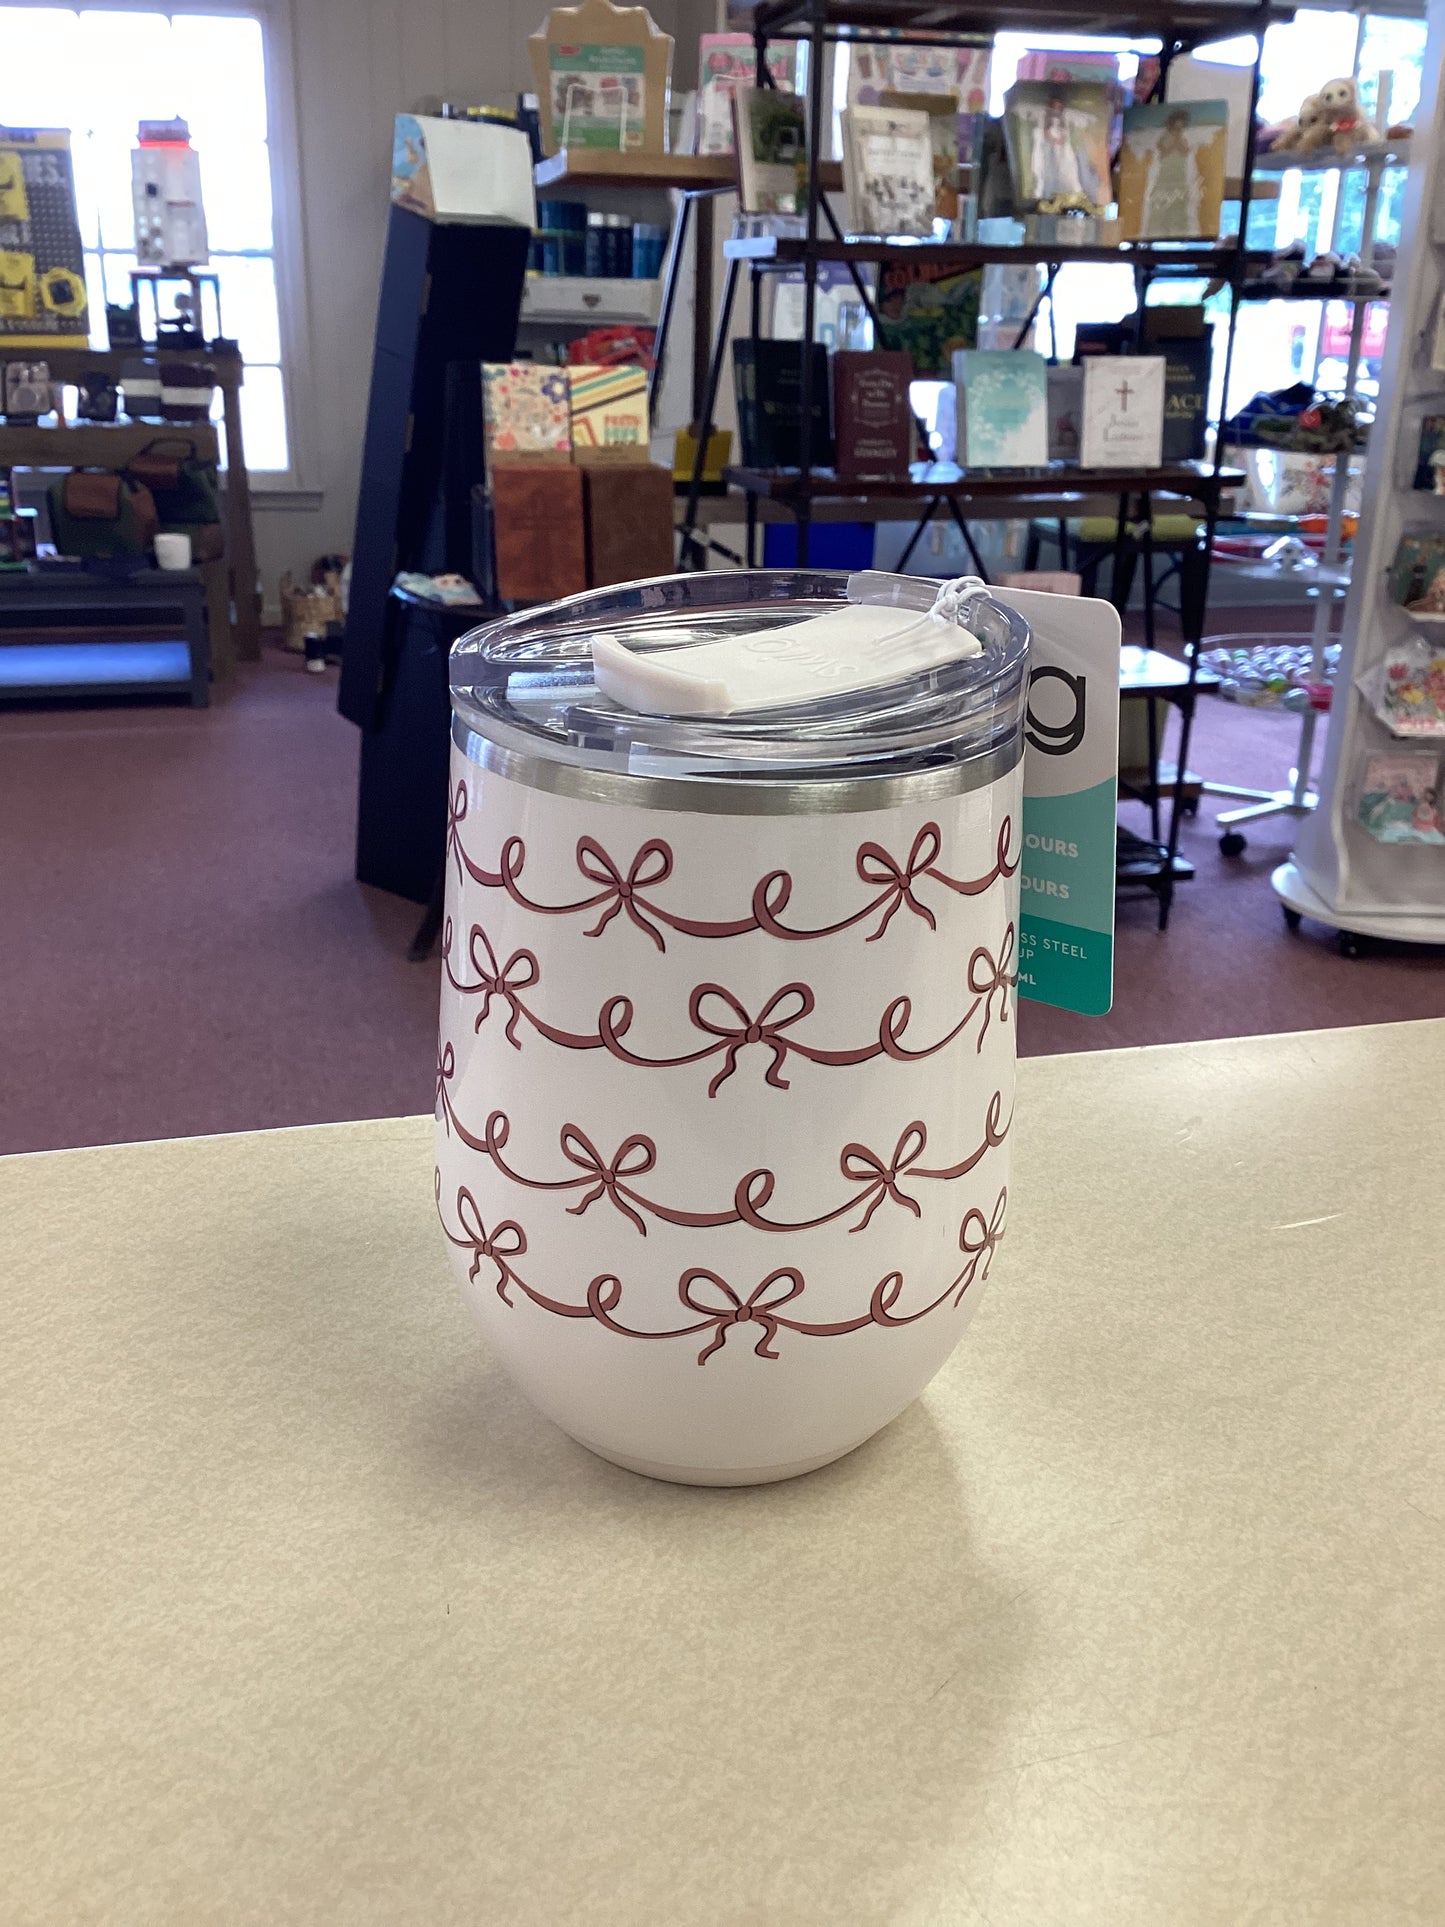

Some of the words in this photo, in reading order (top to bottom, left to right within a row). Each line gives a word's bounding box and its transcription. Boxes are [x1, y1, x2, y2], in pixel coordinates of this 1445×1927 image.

[1024, 833, 1079, 859] OURS
[1020, 874, 1070, 899] OURS
[1020, 932, 1037, 947] SS
[1042, 938, 1088, 960] STEEL
